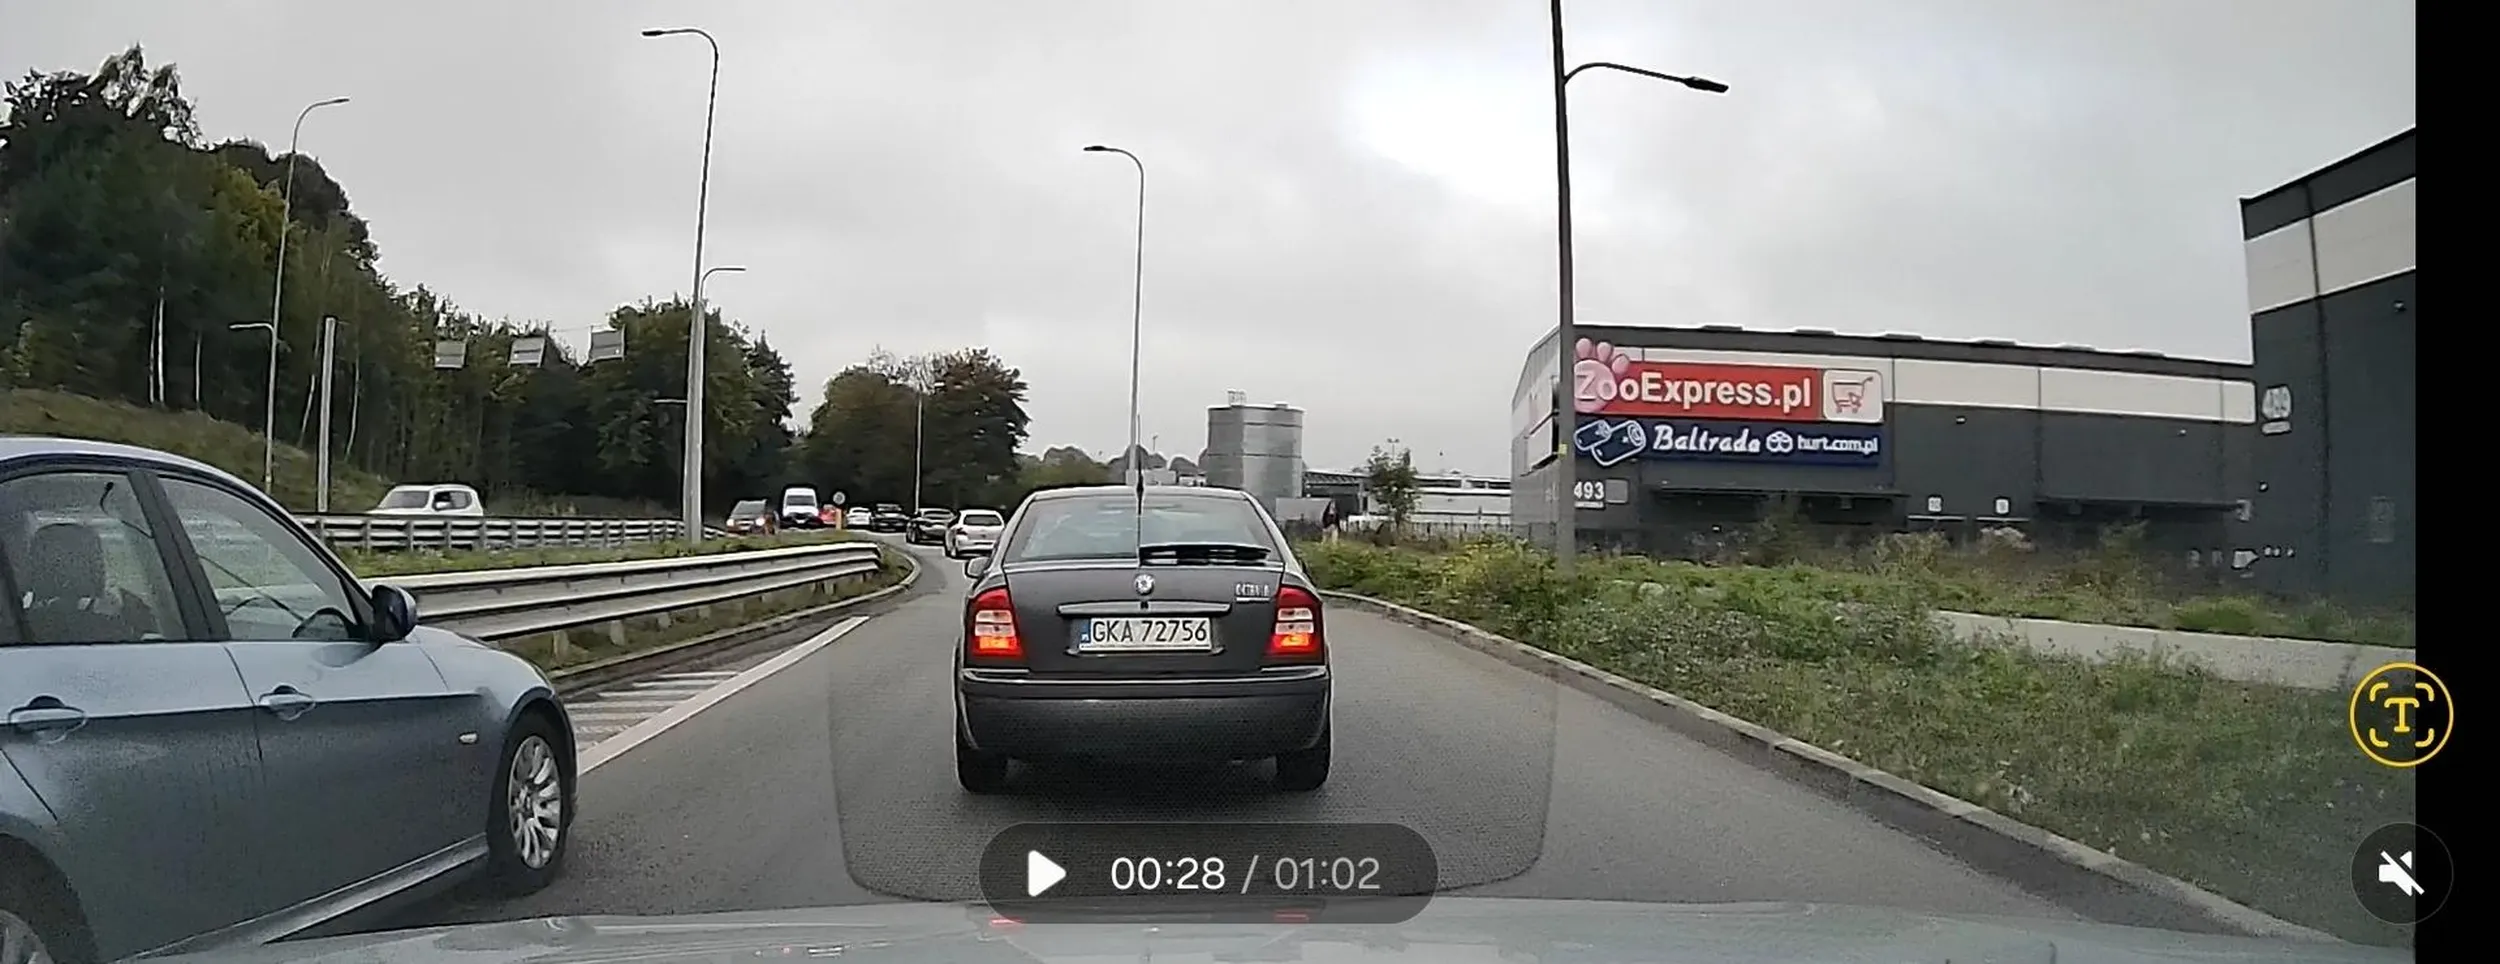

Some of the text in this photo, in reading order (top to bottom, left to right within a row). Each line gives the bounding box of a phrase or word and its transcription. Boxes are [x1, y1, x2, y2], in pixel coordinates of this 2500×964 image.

[1575, 371, 1811, 414] ZooExpress.pl
[1652, 424, 1878, 455] Baltrada hurt.com.pl
[1573, 481, 1604, 500] 493
[1092, 620, 1207, 643] GKA 72756
